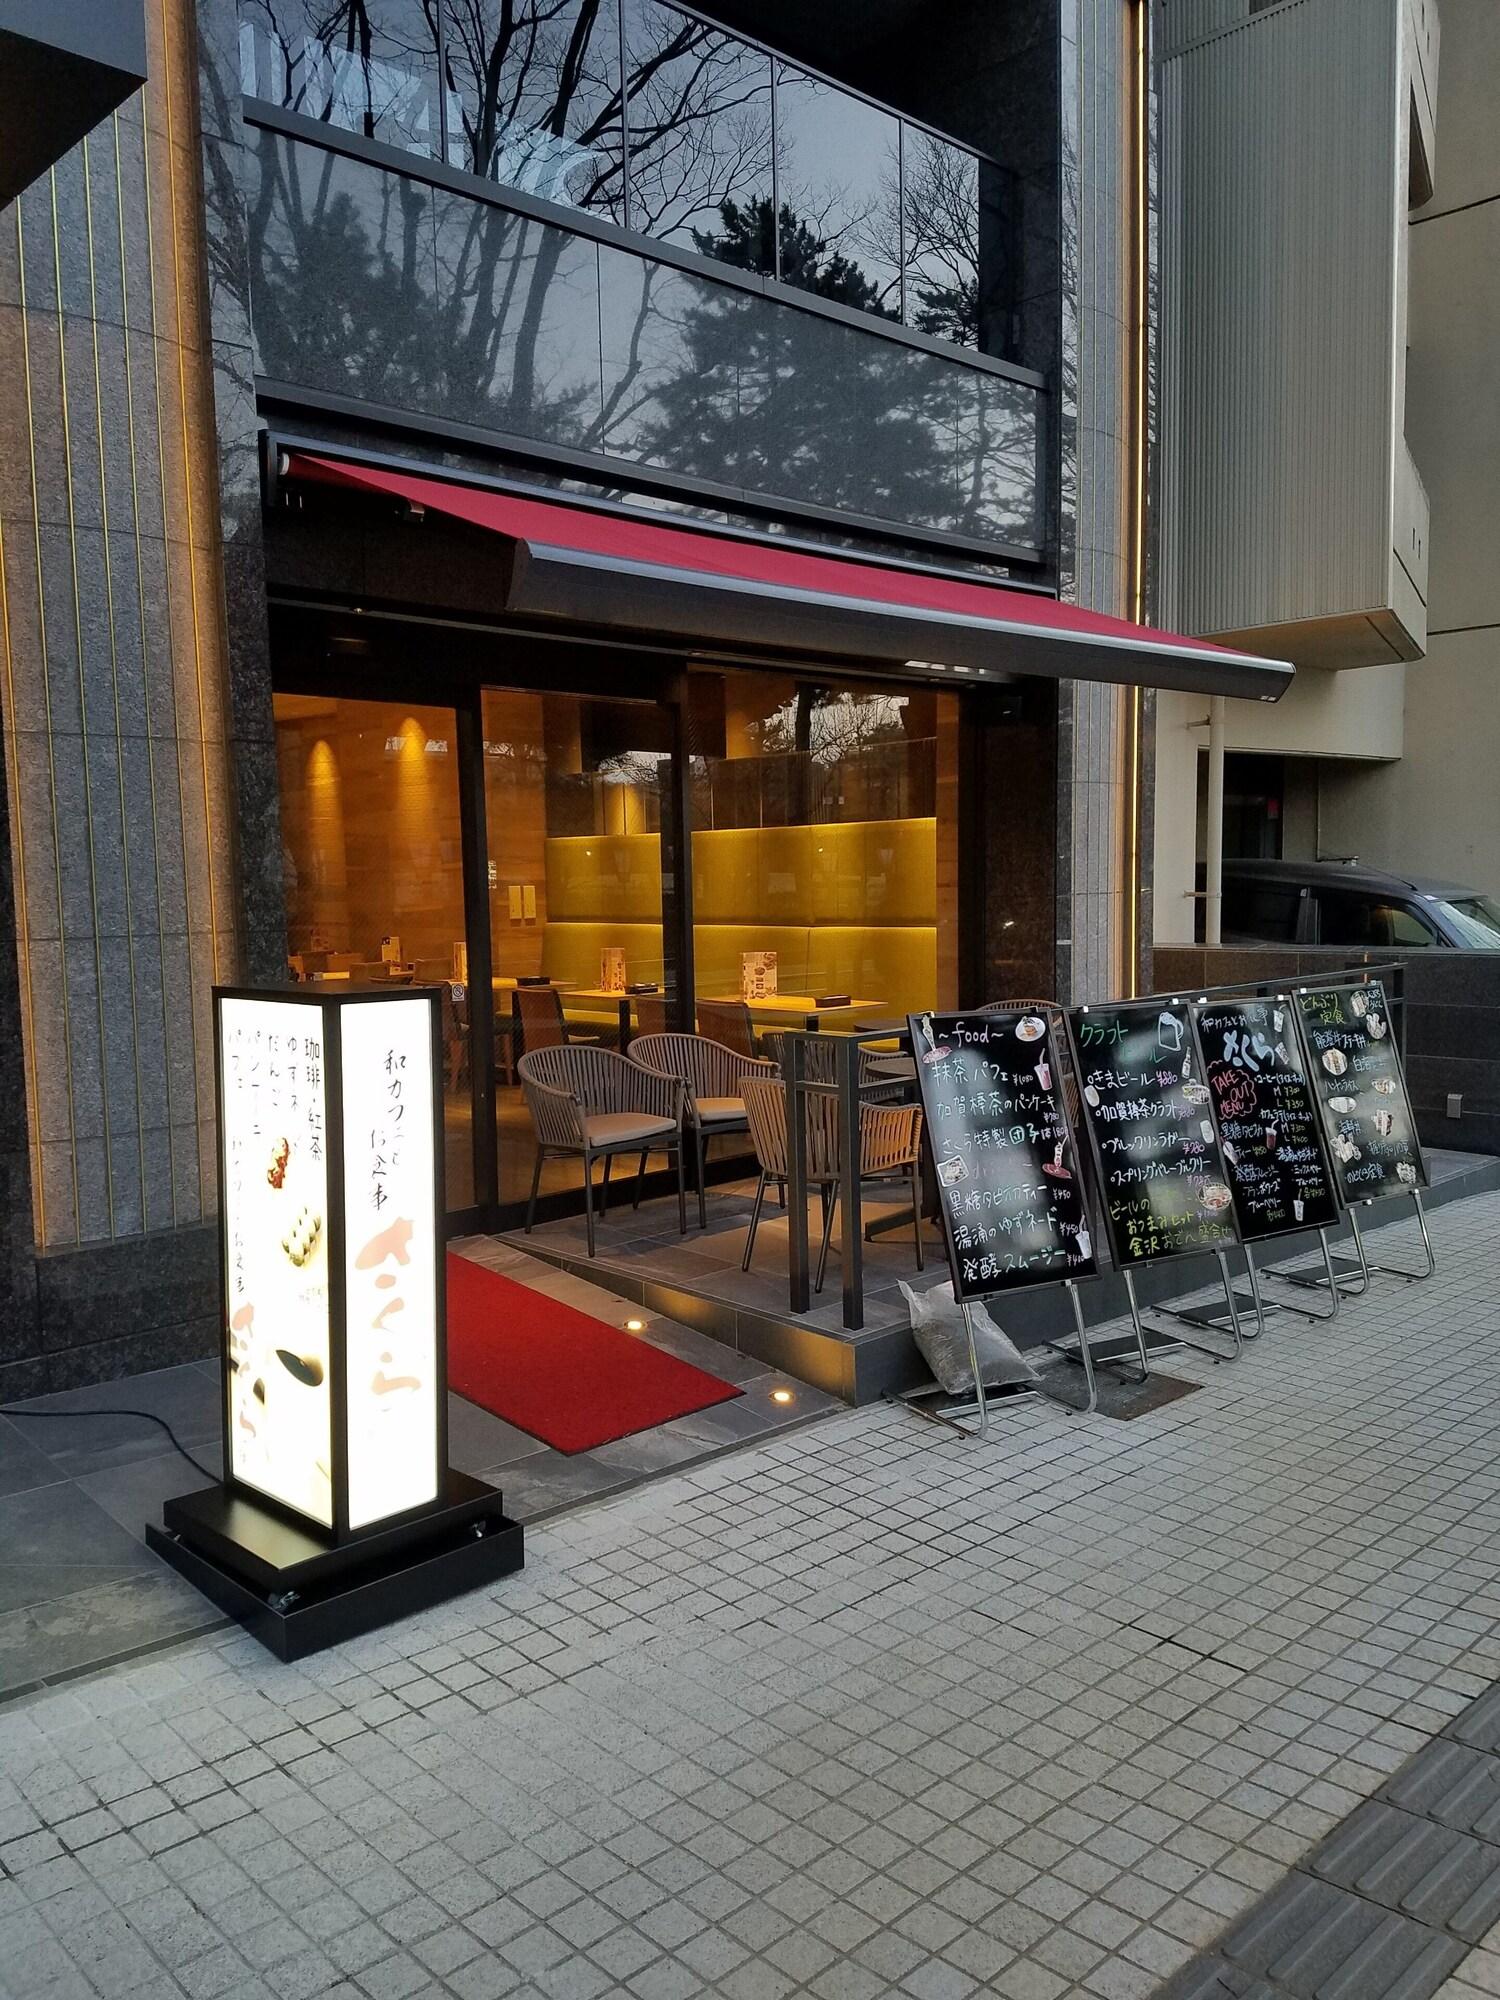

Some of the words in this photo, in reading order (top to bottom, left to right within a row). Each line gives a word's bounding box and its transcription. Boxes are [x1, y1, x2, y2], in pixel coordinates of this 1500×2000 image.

[1080, 1020, 1129, 1047] クラフト
[1211, 1070, 1239, 1095] TAKE
[1230, 1081, 1250, 1102] OUT
